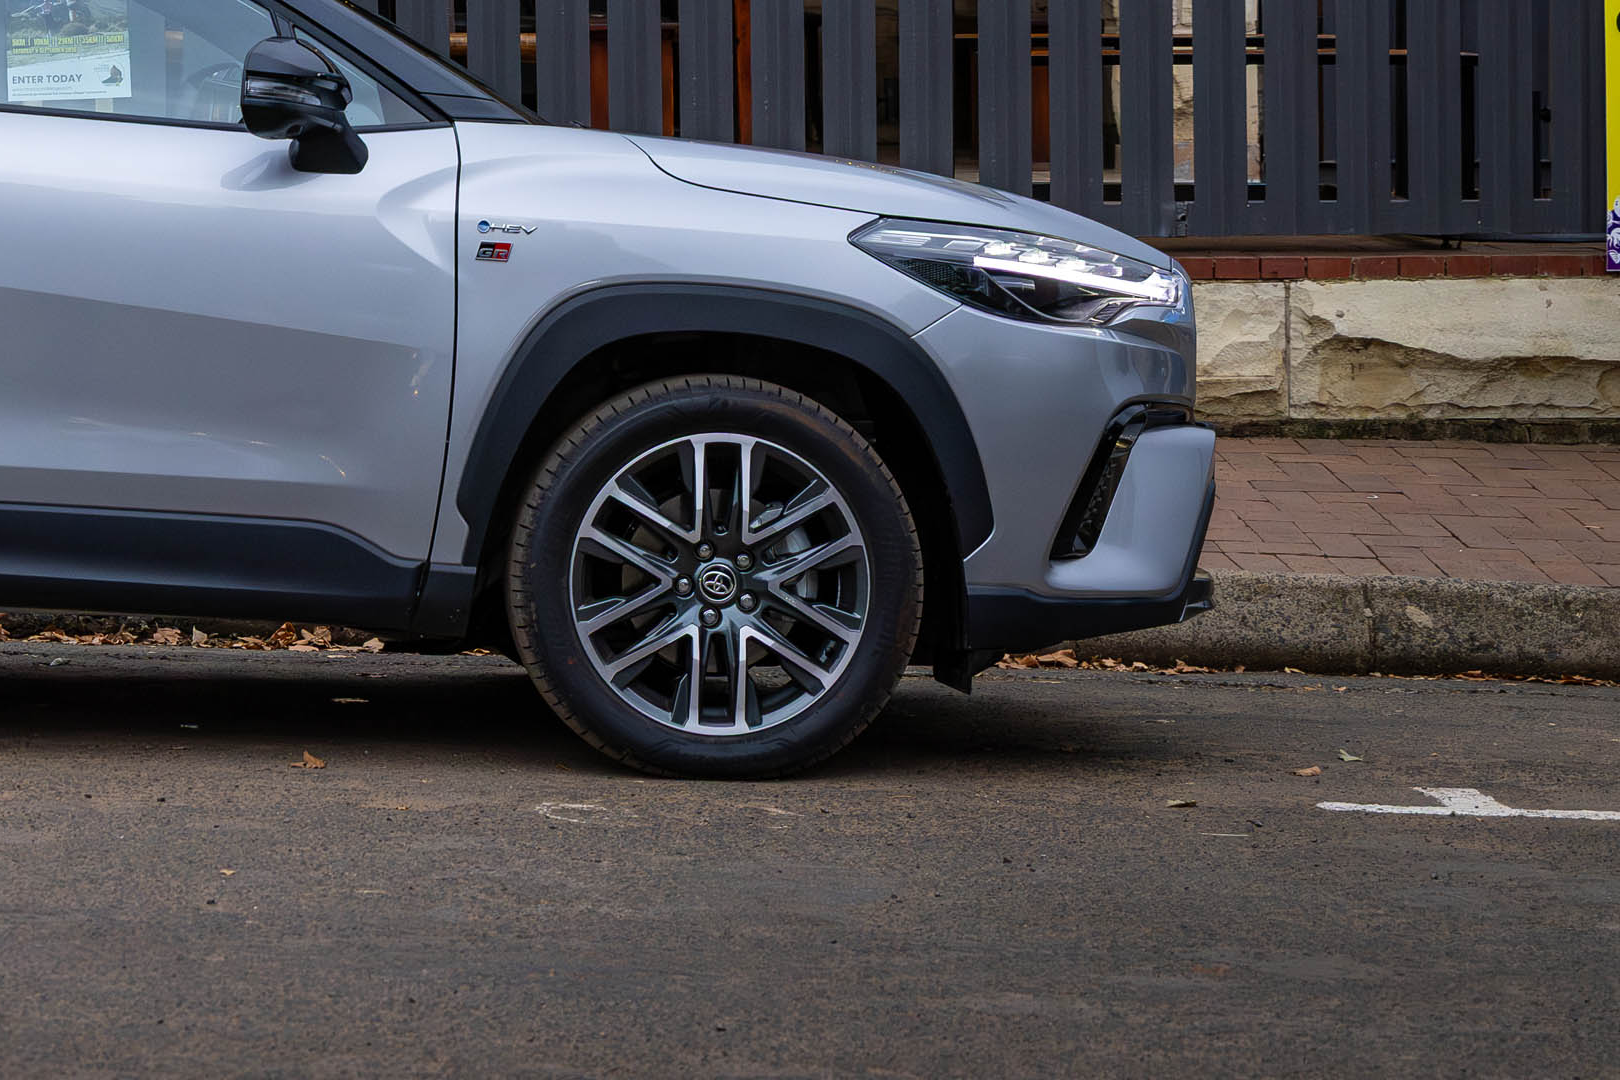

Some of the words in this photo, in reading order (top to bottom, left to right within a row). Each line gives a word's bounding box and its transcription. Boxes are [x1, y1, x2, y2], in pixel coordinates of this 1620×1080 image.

[12, 75, 44, 84] ENTER
[46, 74, 82, 83] TODAY
[490, 223, 538, 235] HEV
[478, 247, 508, 258] GR
